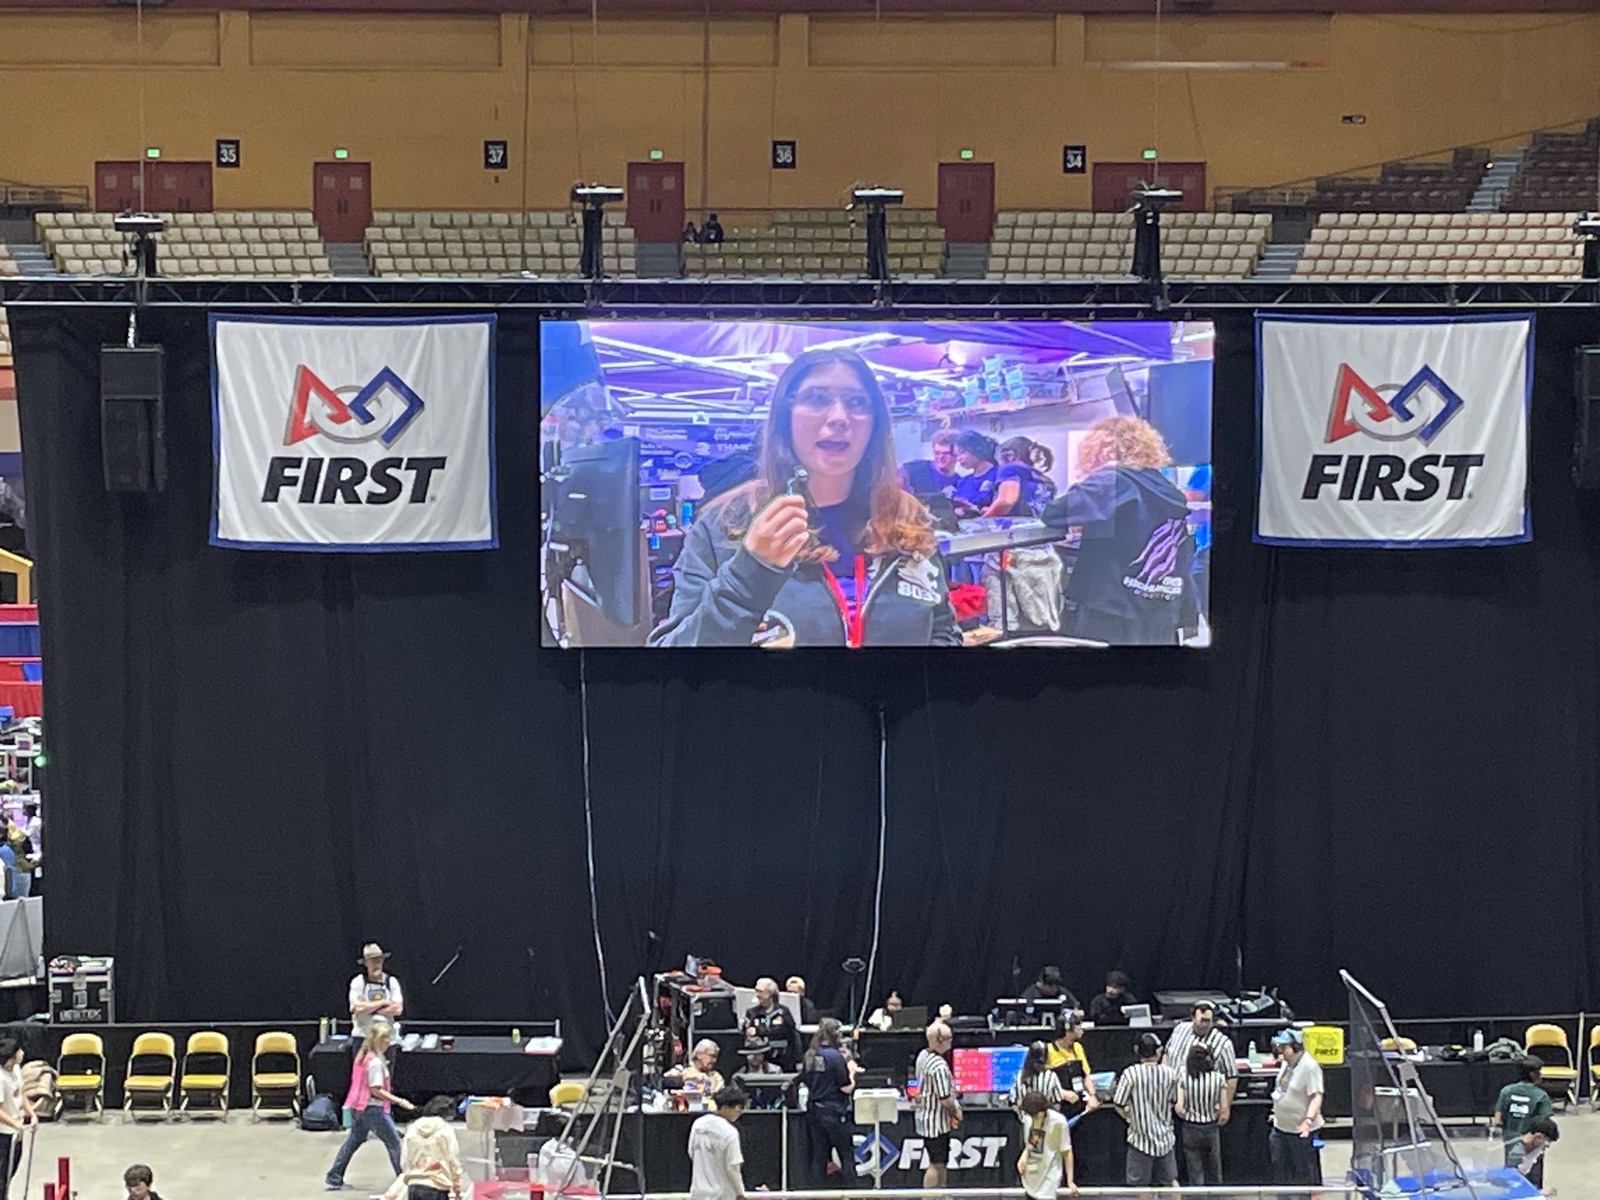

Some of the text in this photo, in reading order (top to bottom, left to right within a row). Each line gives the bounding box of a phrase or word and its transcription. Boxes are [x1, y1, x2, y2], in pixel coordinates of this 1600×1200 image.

[220, 149, 236, 163] 35
[489, 149, 504, 163] 37
[1067, 154, 1082, 168] 34
[261, 456, 447, 504] FIRST
[1301, 454, 1485, 501] FIRST
[1314, 1048, 1339, 1056] FIRST
